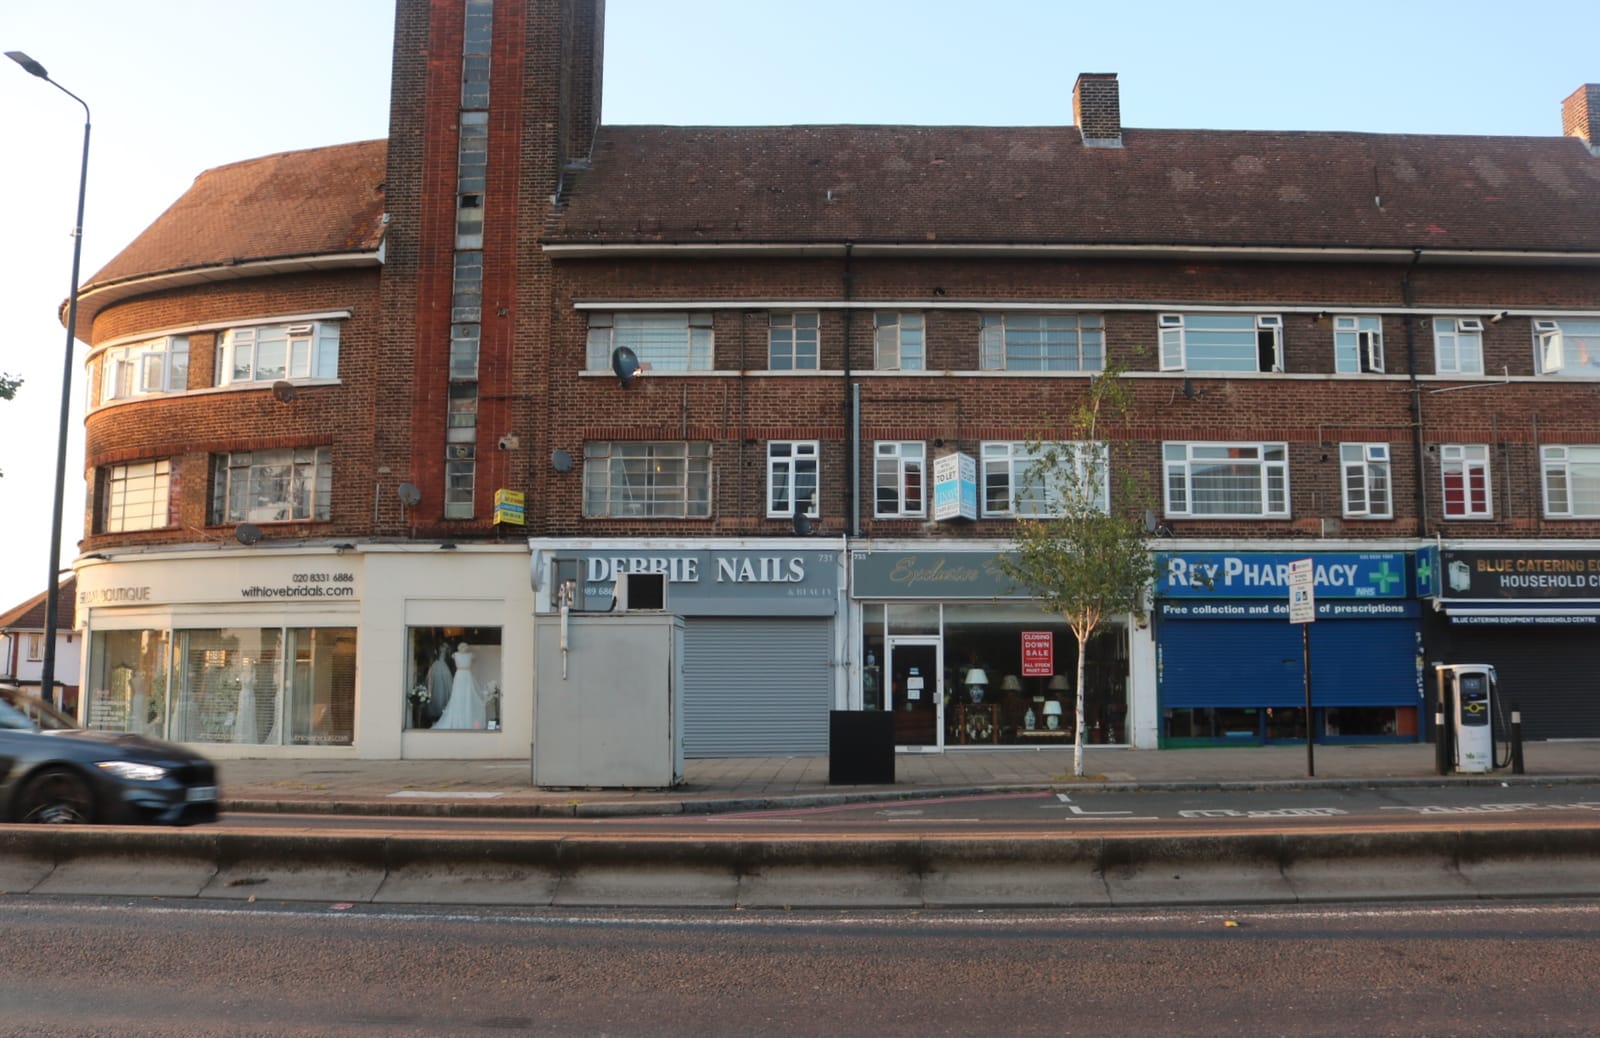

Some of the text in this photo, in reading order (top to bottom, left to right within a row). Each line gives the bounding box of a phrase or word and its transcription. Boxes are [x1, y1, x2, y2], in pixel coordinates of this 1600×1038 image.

[716, 557, 804, 583] NAILS
[1168, 557, 1358, 587] REY PHARACY
[1477, 560, 1513, 572] BLUE
[1517, 560, 1584, 572] CATERING
[293, 574, 308, 583] 020
[310, 574, 330, 583] 8331
[1500, 575, 1586, 588] HOUSEHOLD
[241, 585, 354, 598] withlovebridals.com
[1356, 587, 1376, 596] NHS
[1163, 604, 1188, 614] Free
[1192, 604, 1245, 614] collection
[1249, 604, 1269, 614] and
[1319, 604, 1331, 614] of
[1334, 604, 1404, 615] prescriptions
